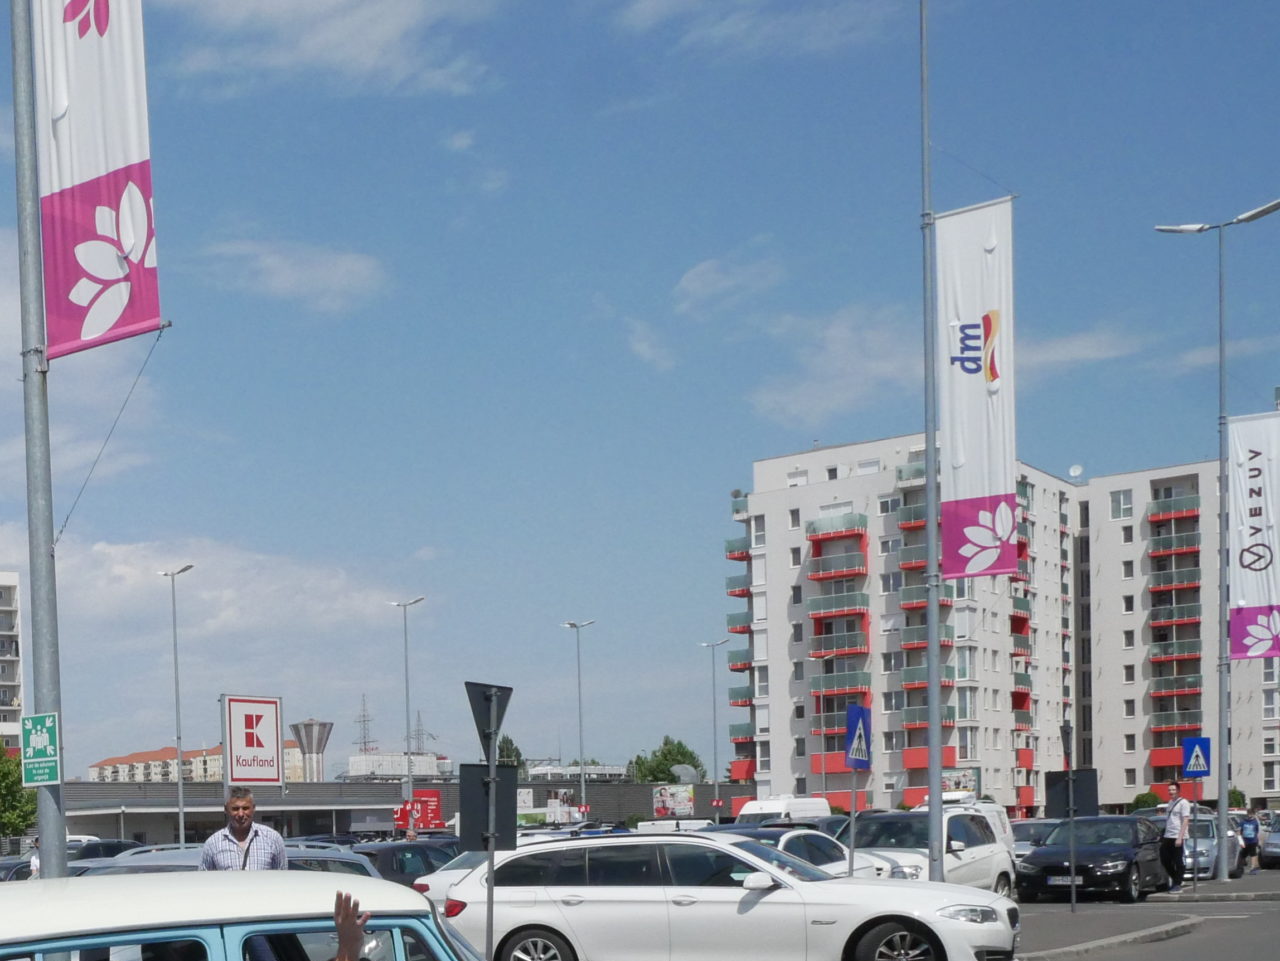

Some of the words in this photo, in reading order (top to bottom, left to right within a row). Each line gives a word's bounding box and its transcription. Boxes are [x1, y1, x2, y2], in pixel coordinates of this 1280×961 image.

[950, 323, 982, 374] dm
[1248, 449, 1262, 537] VEZUV
[236, 755, 274, 767] Kaufland
